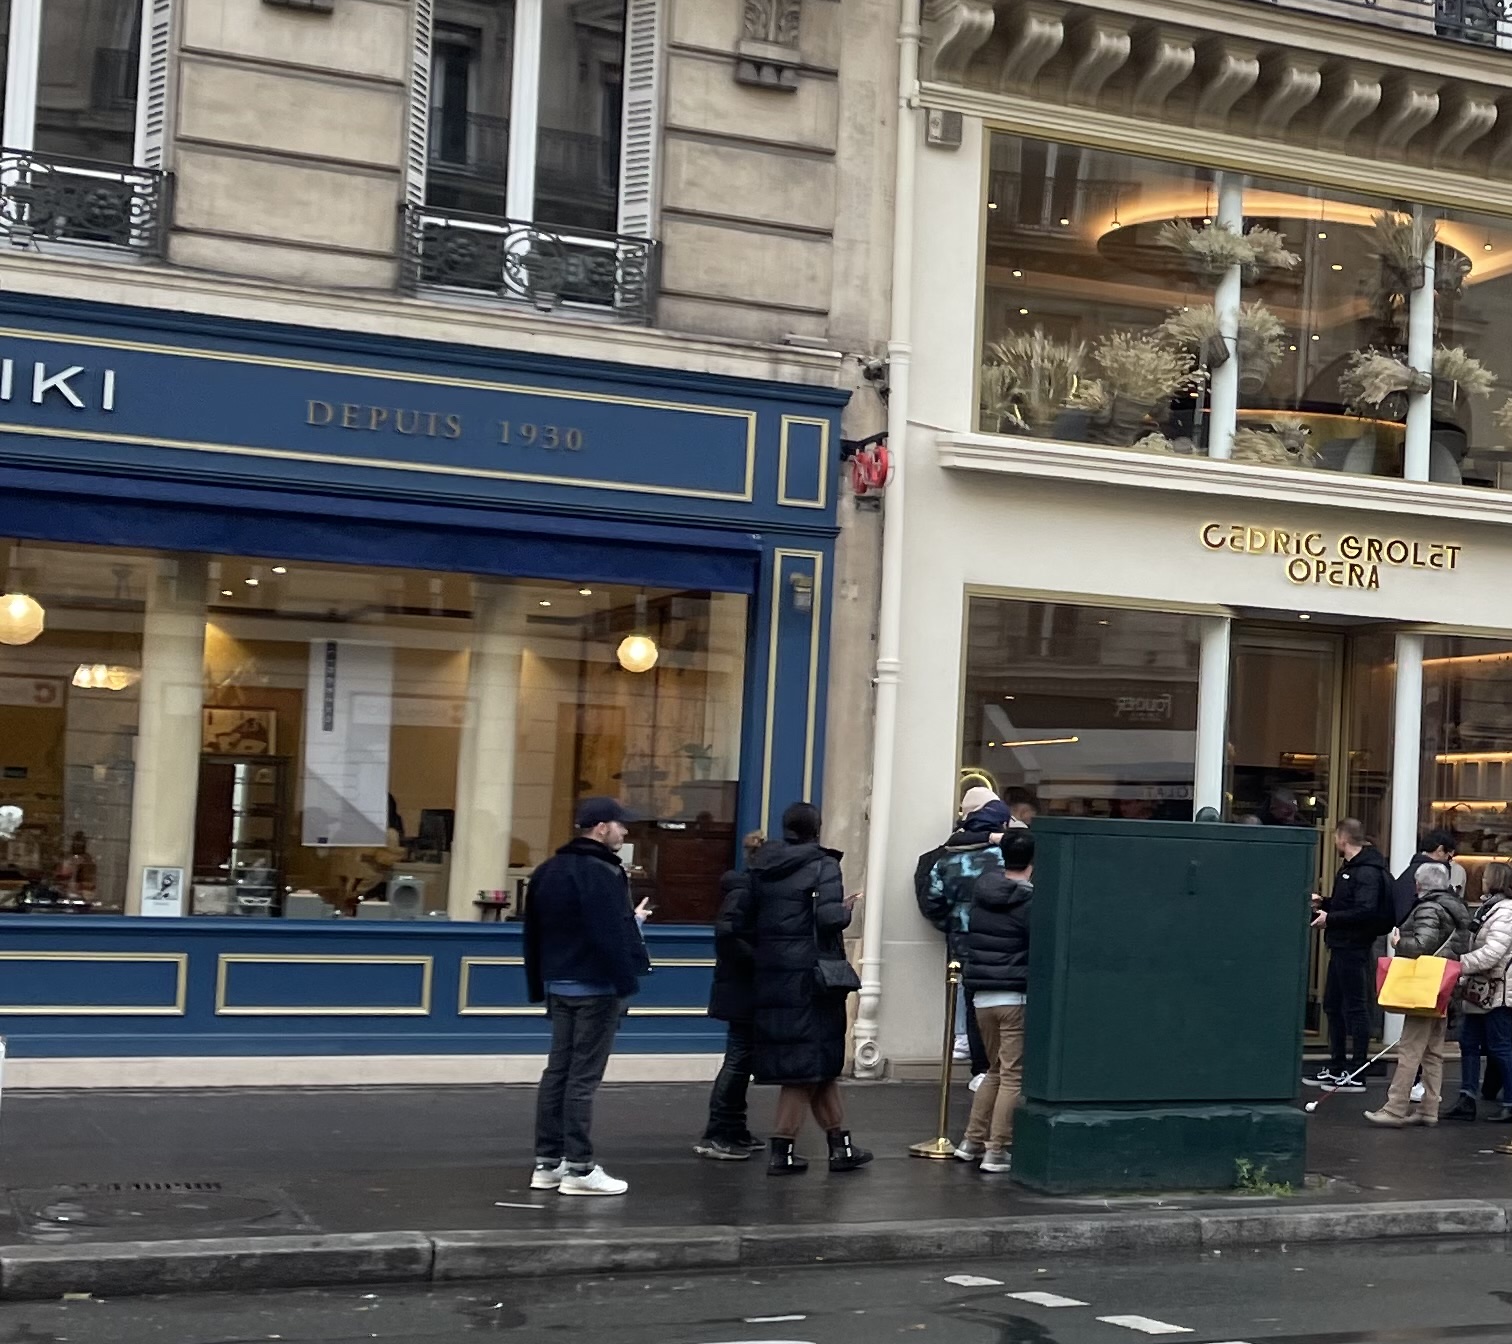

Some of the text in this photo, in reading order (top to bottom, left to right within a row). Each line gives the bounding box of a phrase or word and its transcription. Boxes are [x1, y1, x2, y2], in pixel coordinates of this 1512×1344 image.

[303, 398, 584, 453] DEPUIS 1930
[1339, 534, 1462, 570] GROLET
[1286, 557, 1381, 591] OPERA
